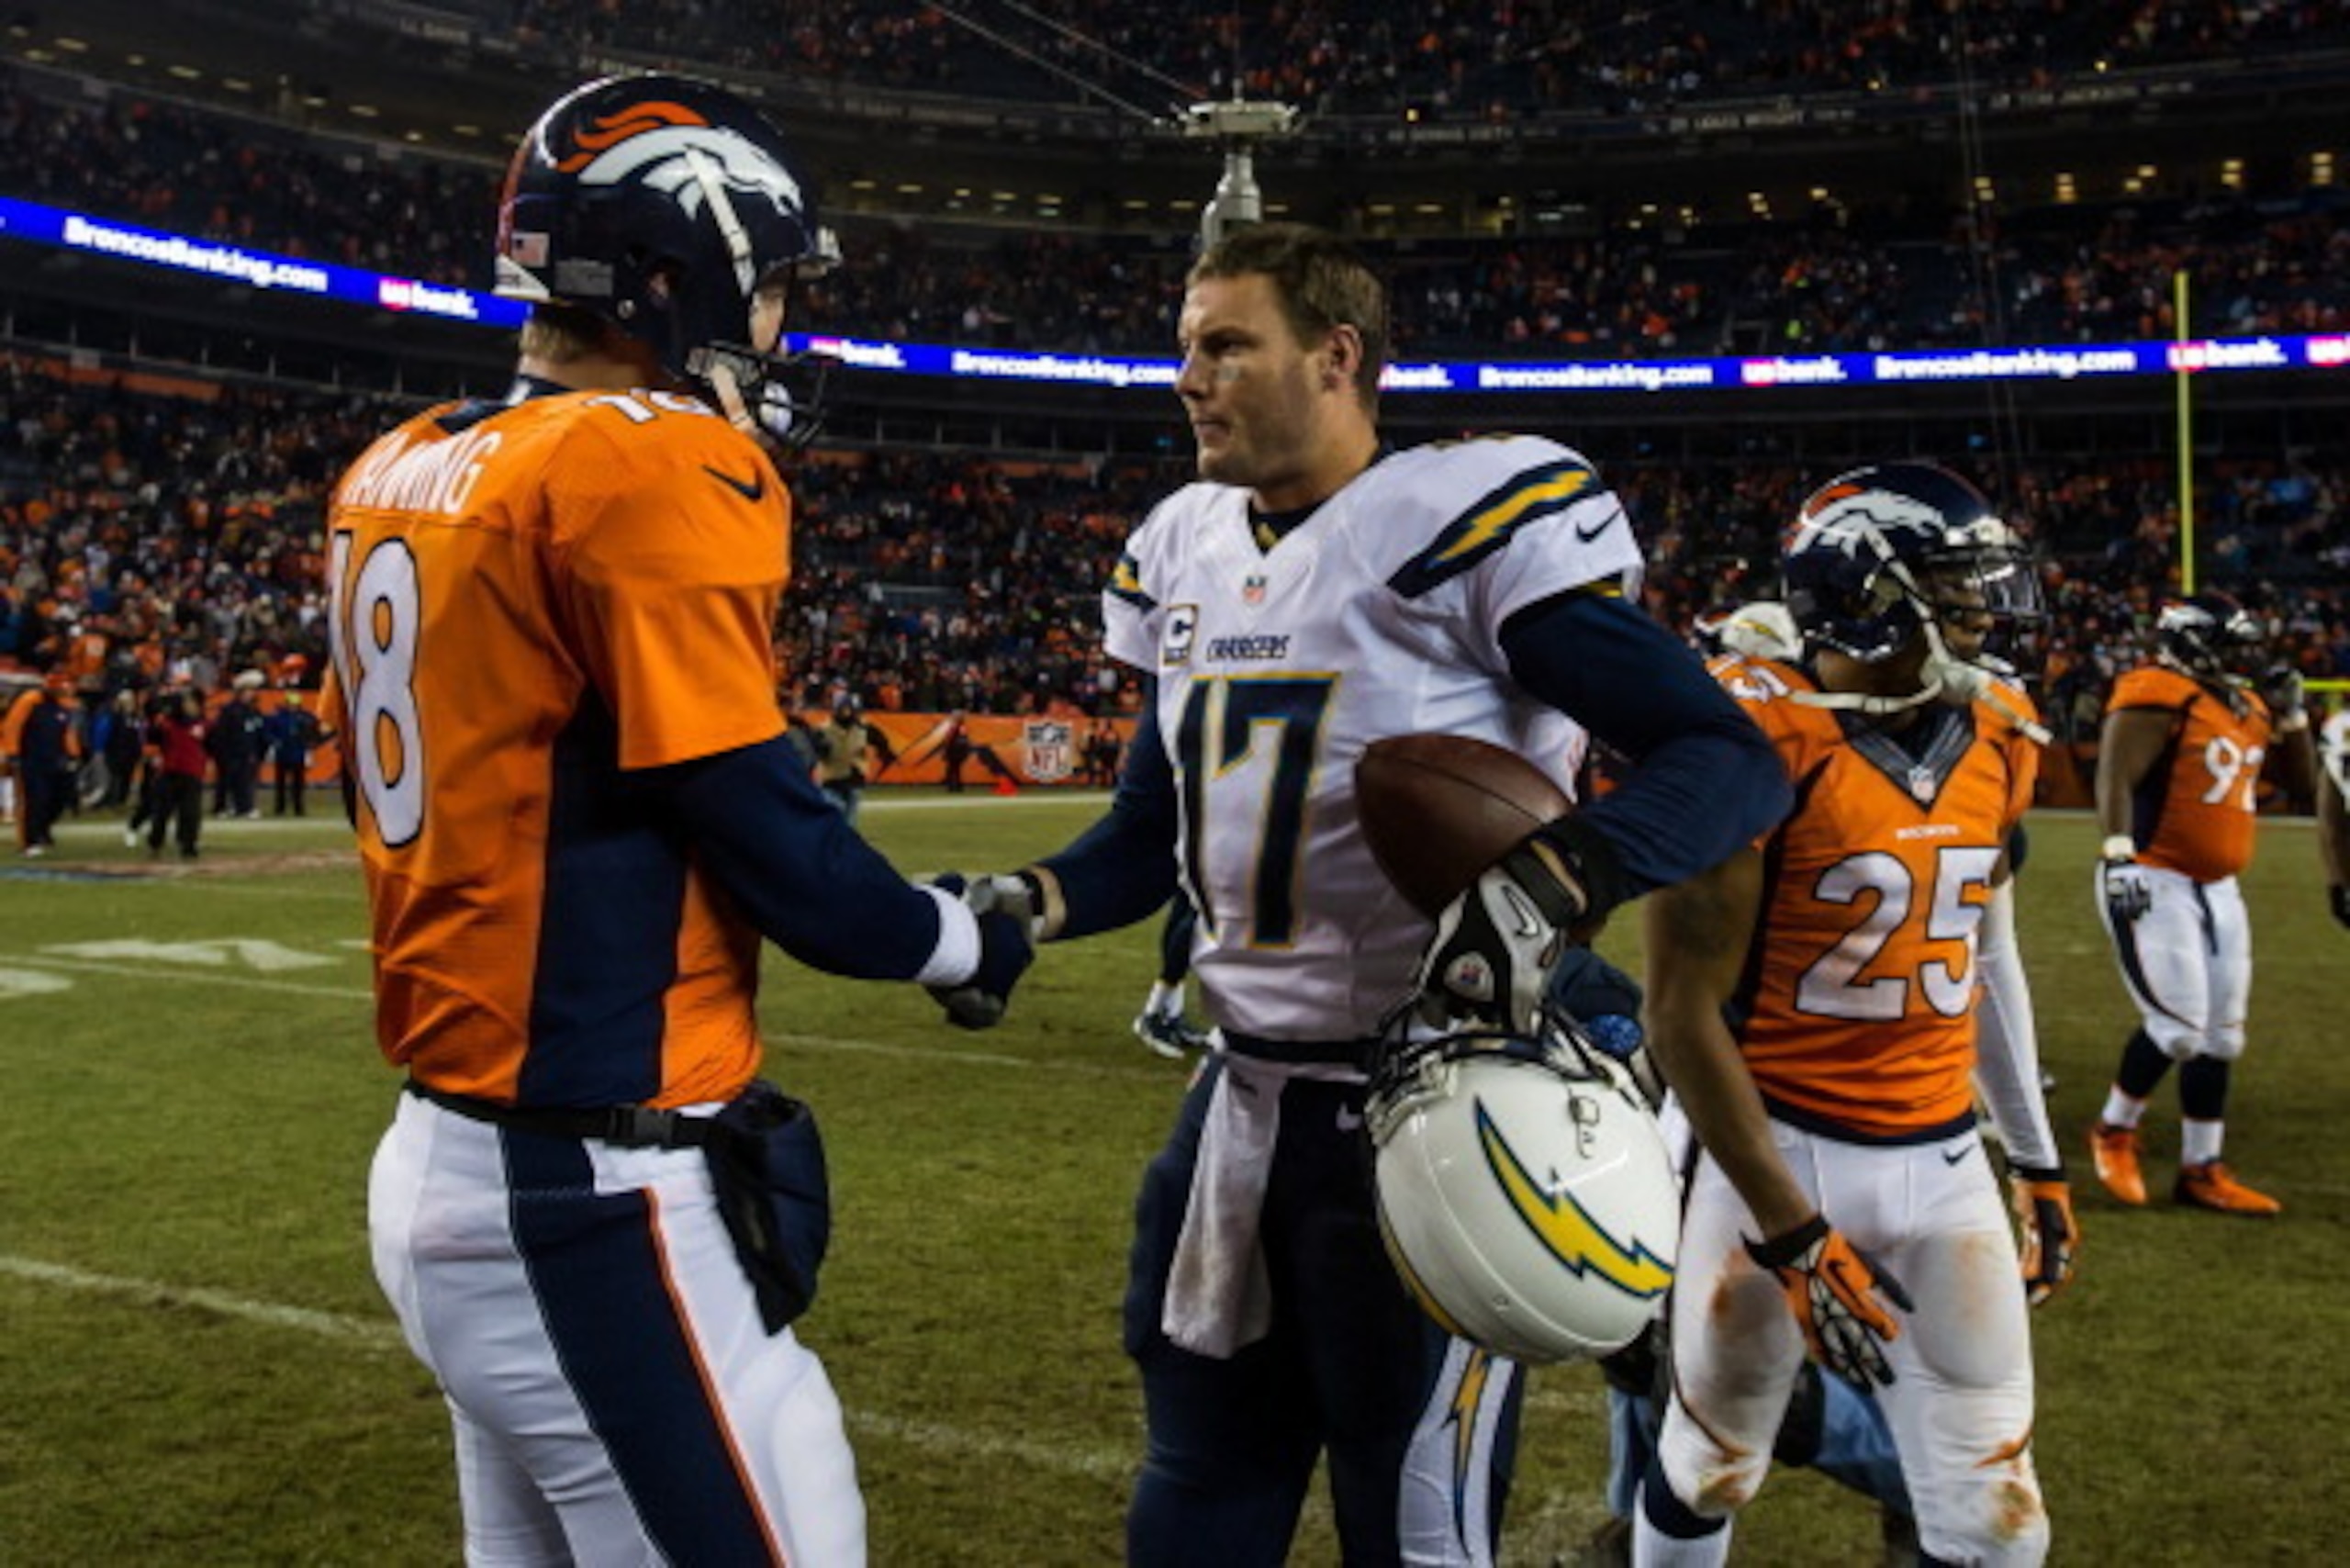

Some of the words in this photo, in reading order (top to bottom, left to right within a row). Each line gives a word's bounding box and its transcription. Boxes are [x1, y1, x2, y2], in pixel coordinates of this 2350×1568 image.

[63, 216, 328, 292] BroncosBanking.com
[1479, 363, 1713, 391] BroncosBanking.com
[1875, 348, 2136, 379] BroncosBanking.com
[340, 429, 503, 514] ANNING
[329, 528, 425, 847] 18
[1175, 671, 1341, 950] 17
[1796, 845, 2002, 1021] 25
